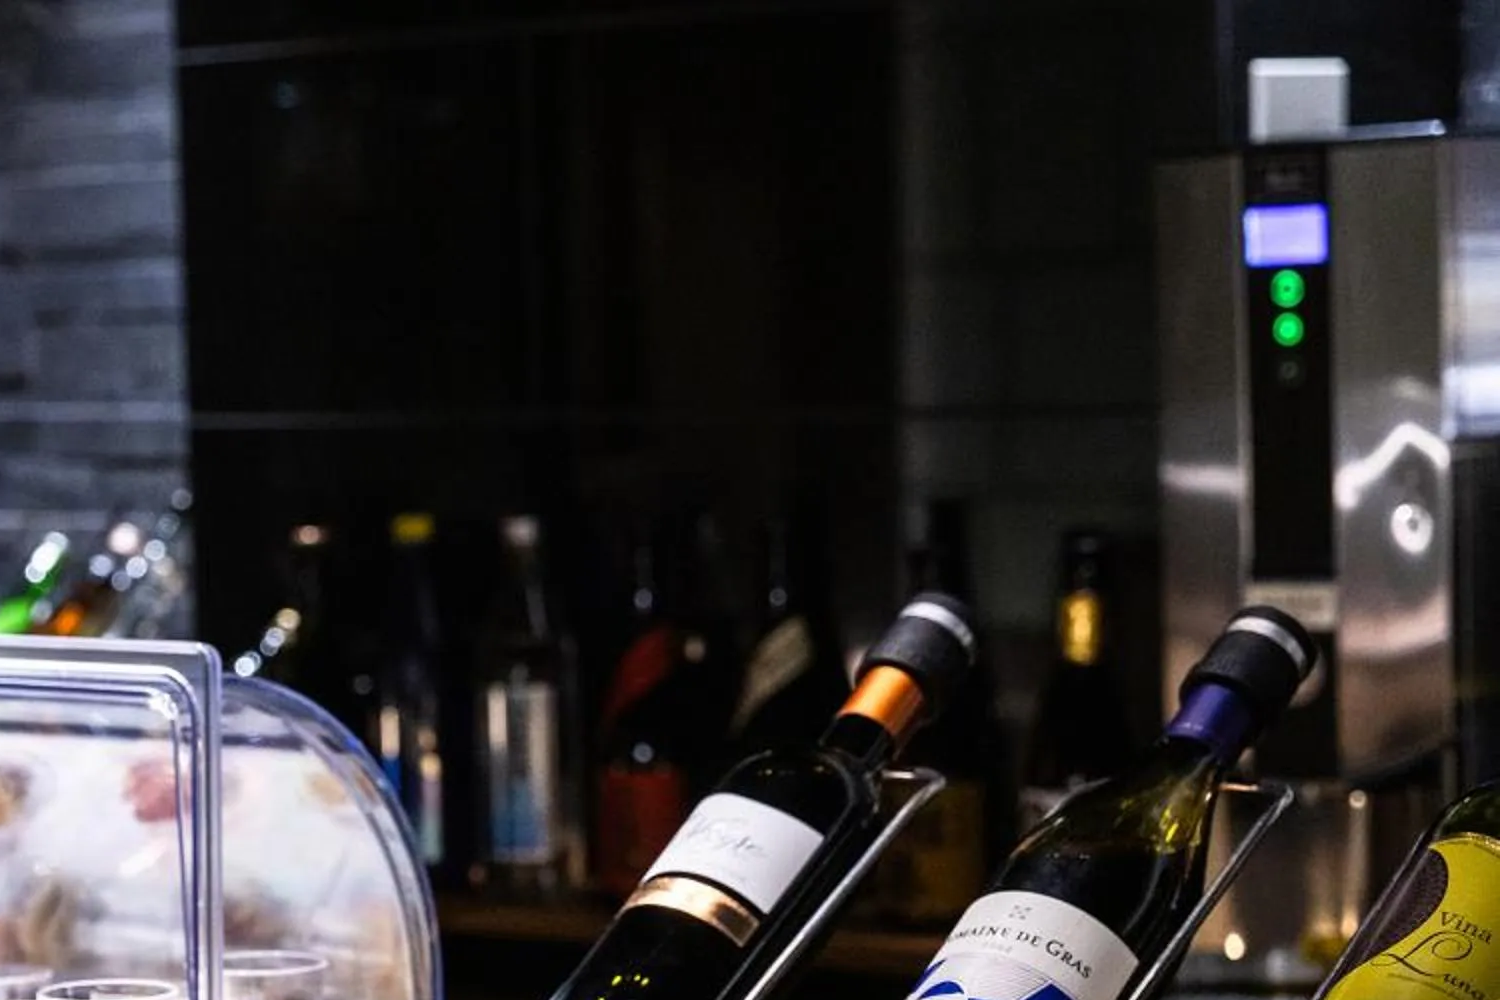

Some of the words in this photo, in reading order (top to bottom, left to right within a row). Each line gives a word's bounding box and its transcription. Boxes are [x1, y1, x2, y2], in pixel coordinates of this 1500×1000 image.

[1440, 911, 1492, 944] Vina
[948, 925, 1012, 942] MAINE
[1015, 931, 1042, 947] DE
[1046, 939, 1092, 980] GRAS
